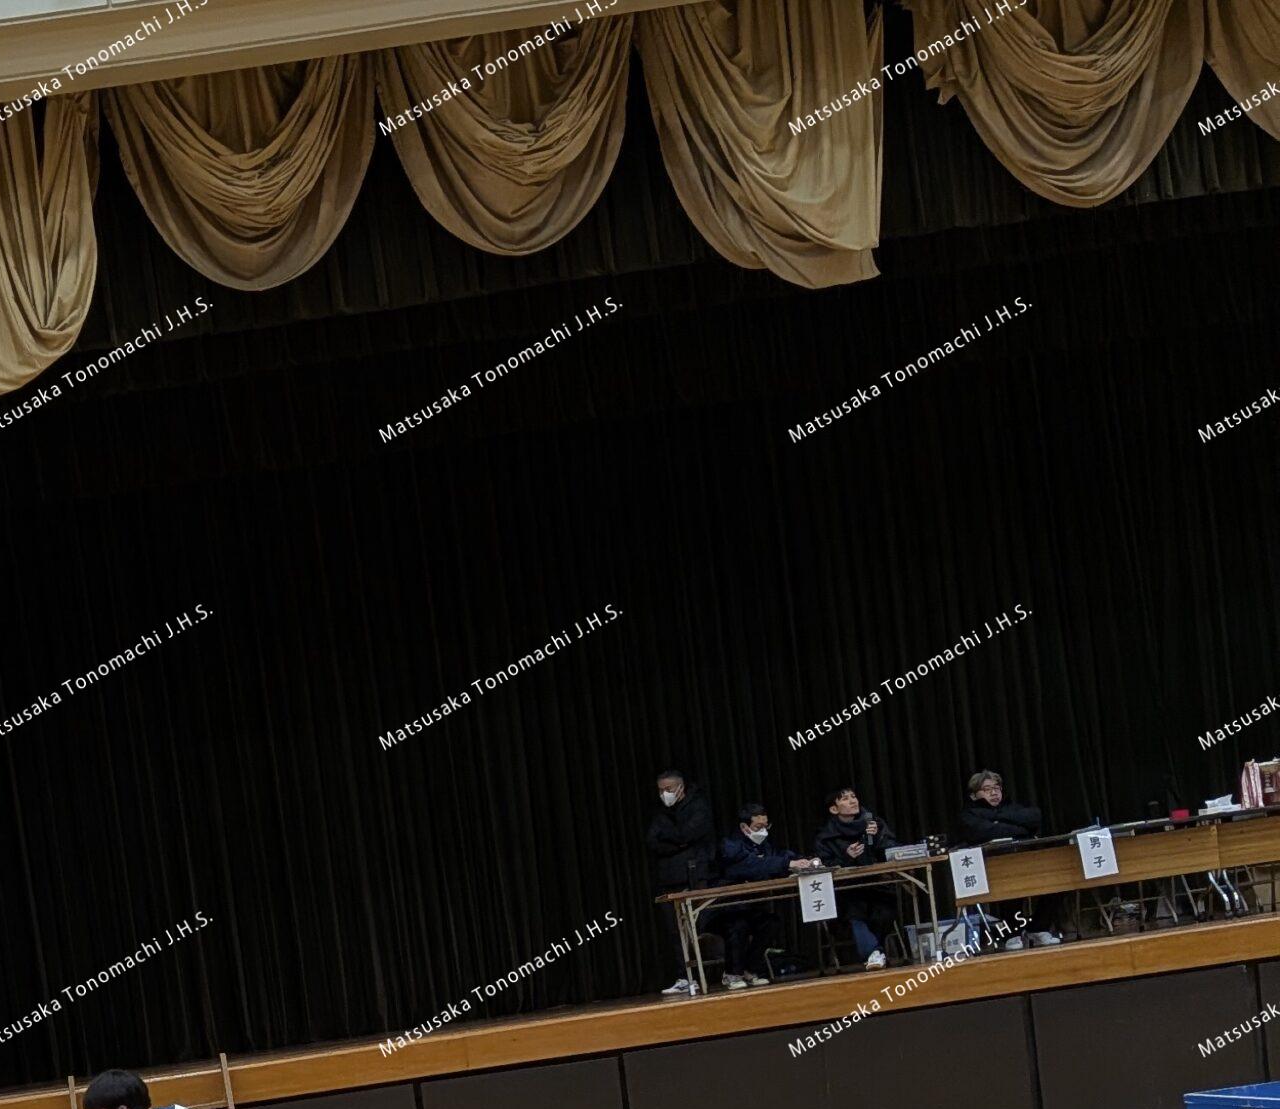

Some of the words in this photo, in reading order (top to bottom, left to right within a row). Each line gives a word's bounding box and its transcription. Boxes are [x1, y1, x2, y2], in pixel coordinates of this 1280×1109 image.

[1089, 836, 1106, 869] 男子
[960, 855, 977, 888] 本部
[809, 880, 825, 912] 女子
